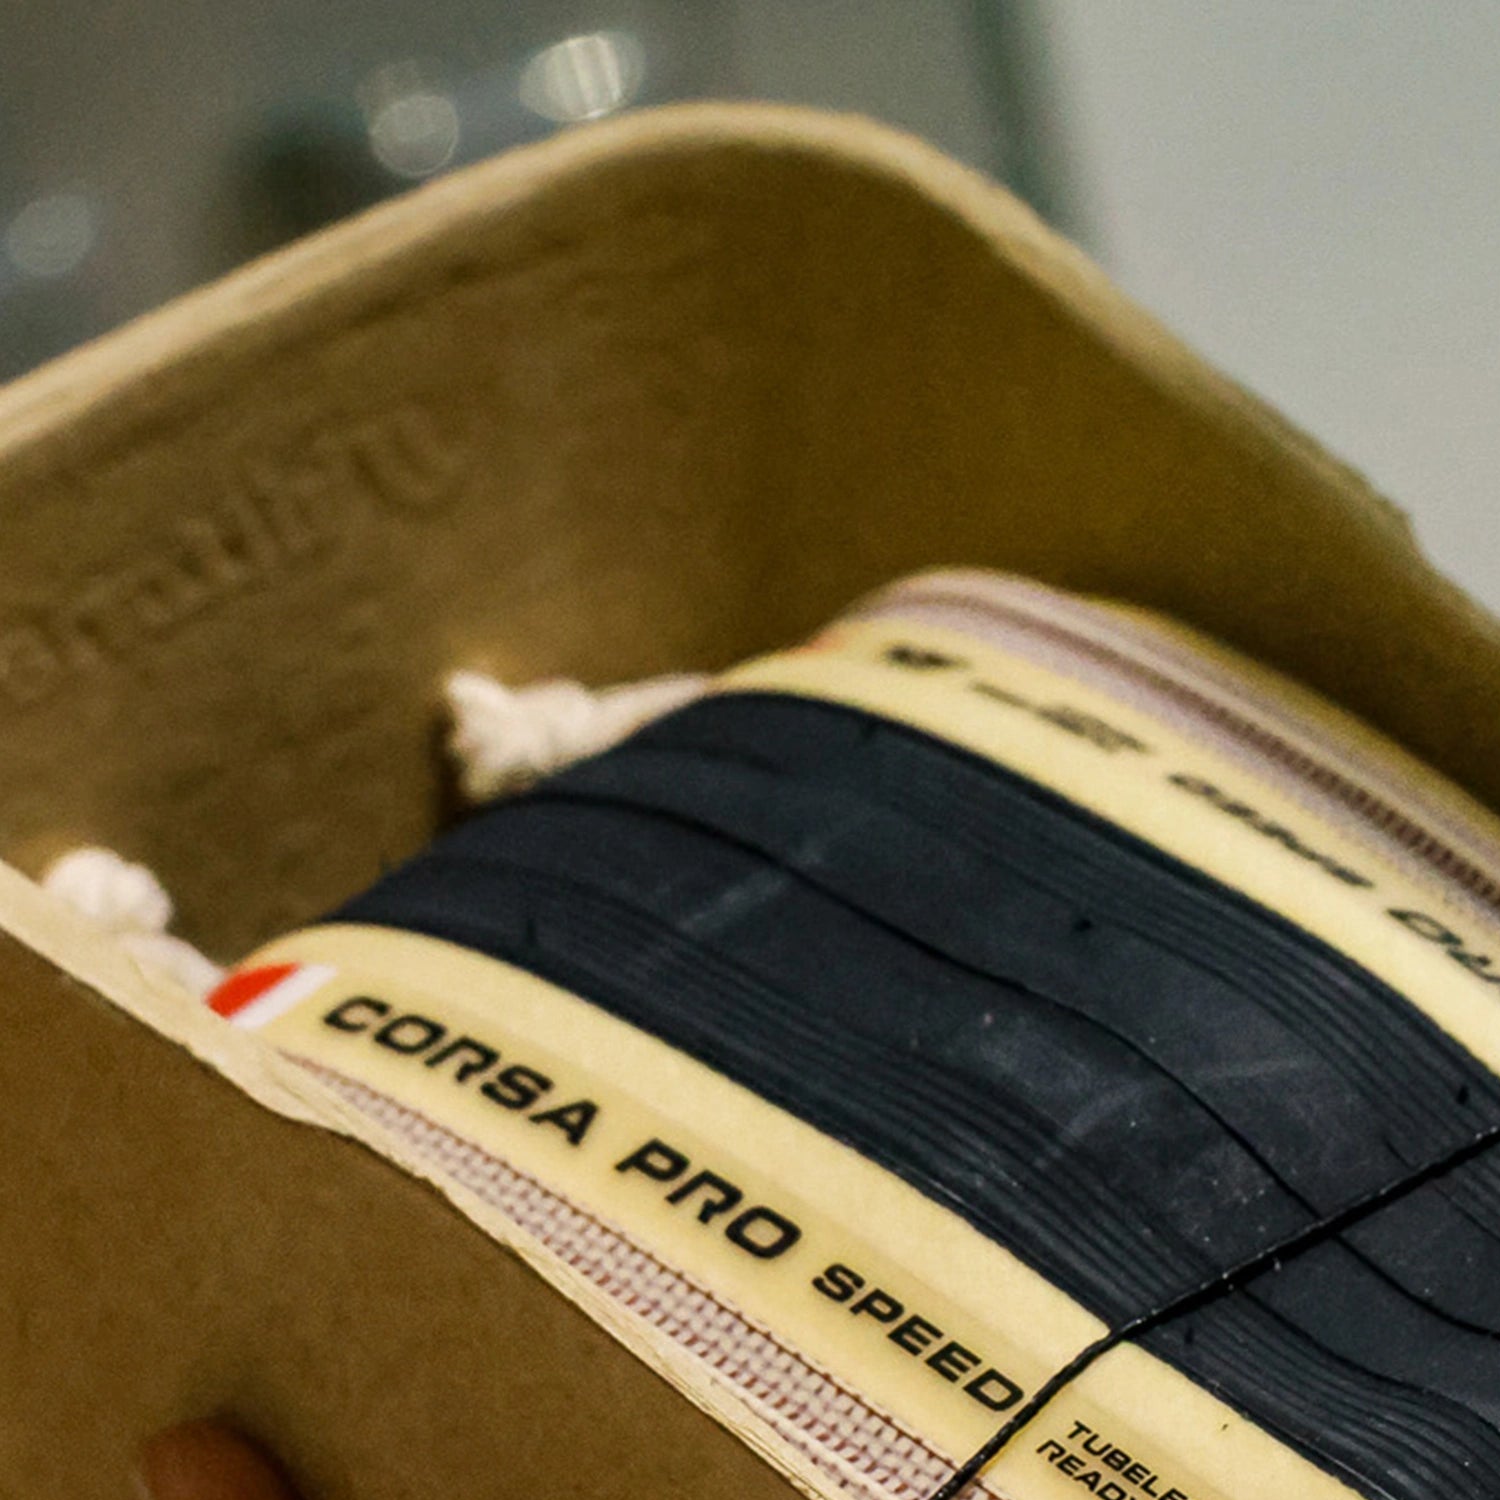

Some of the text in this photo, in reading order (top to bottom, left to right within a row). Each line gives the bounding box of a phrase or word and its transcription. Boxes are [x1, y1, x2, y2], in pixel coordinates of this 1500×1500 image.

[323, 995, 1025, 1413] CORSA PRO SPEED
